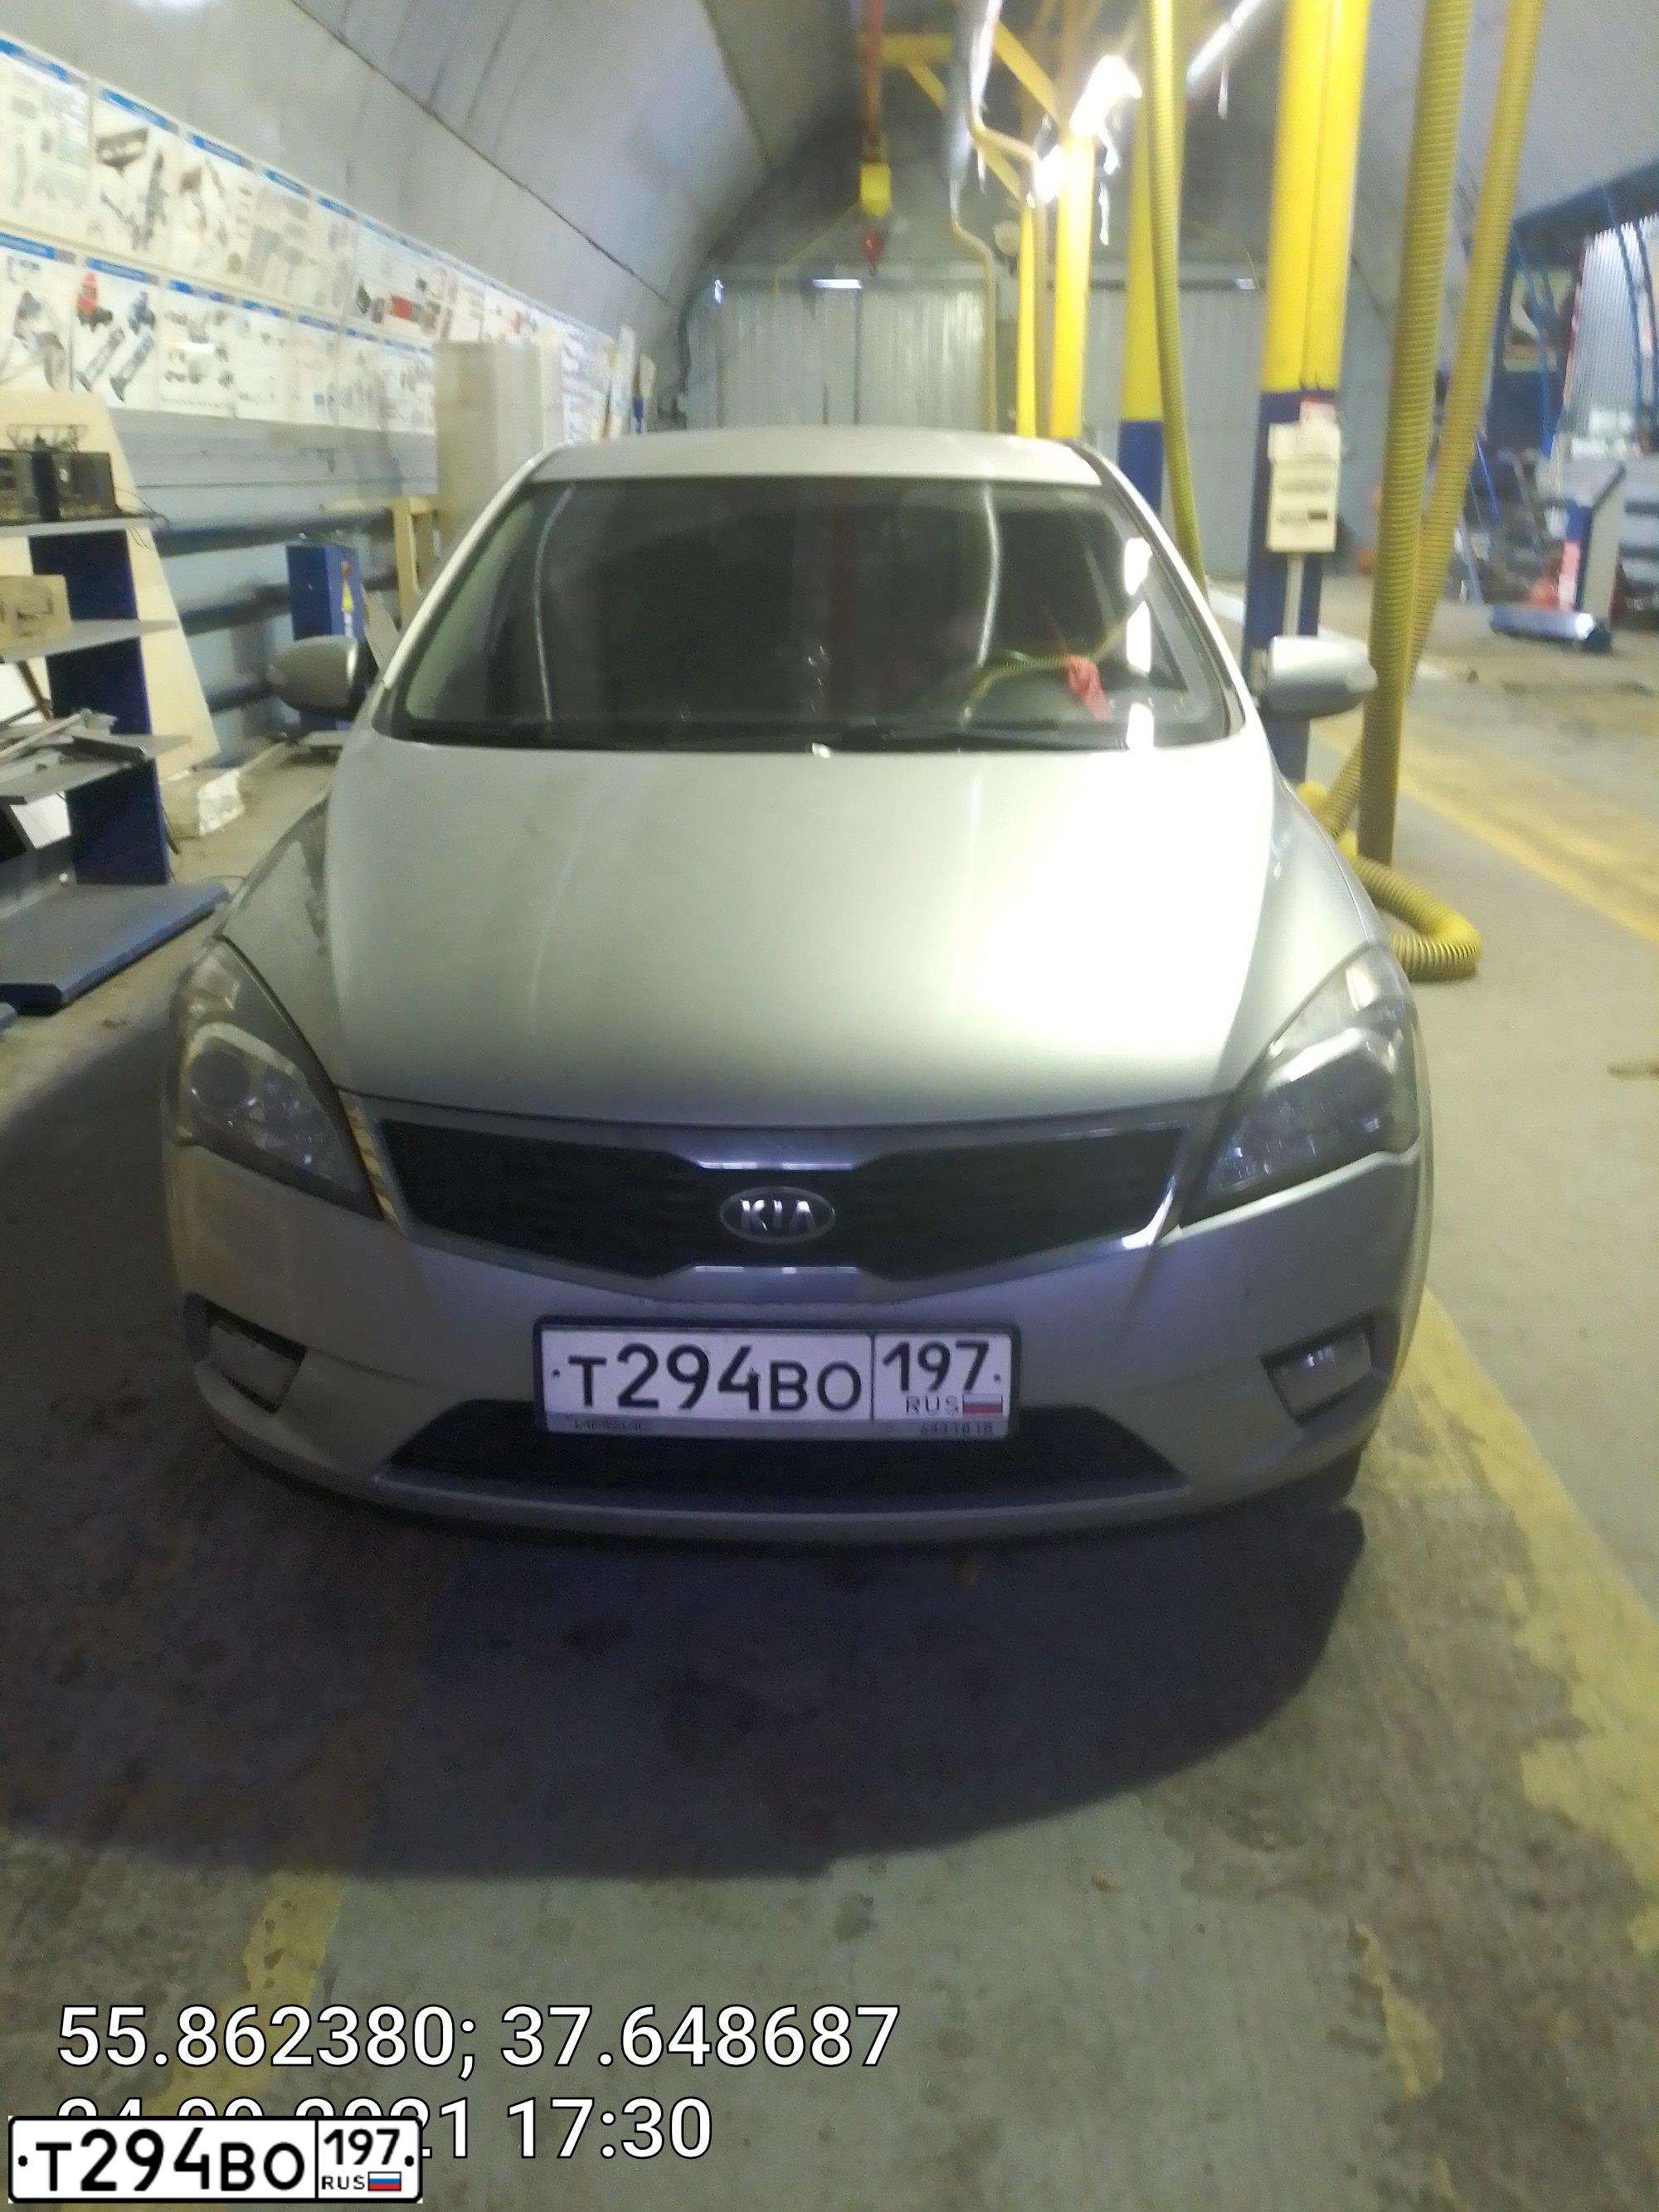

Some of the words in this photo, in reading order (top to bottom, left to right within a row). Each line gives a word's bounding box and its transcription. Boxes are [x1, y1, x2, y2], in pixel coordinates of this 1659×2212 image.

[740, 1200, 815, 1231] KIA
[883, 1341, 989, 1391] 197
[906, 1395, 959, 1414] RUS
